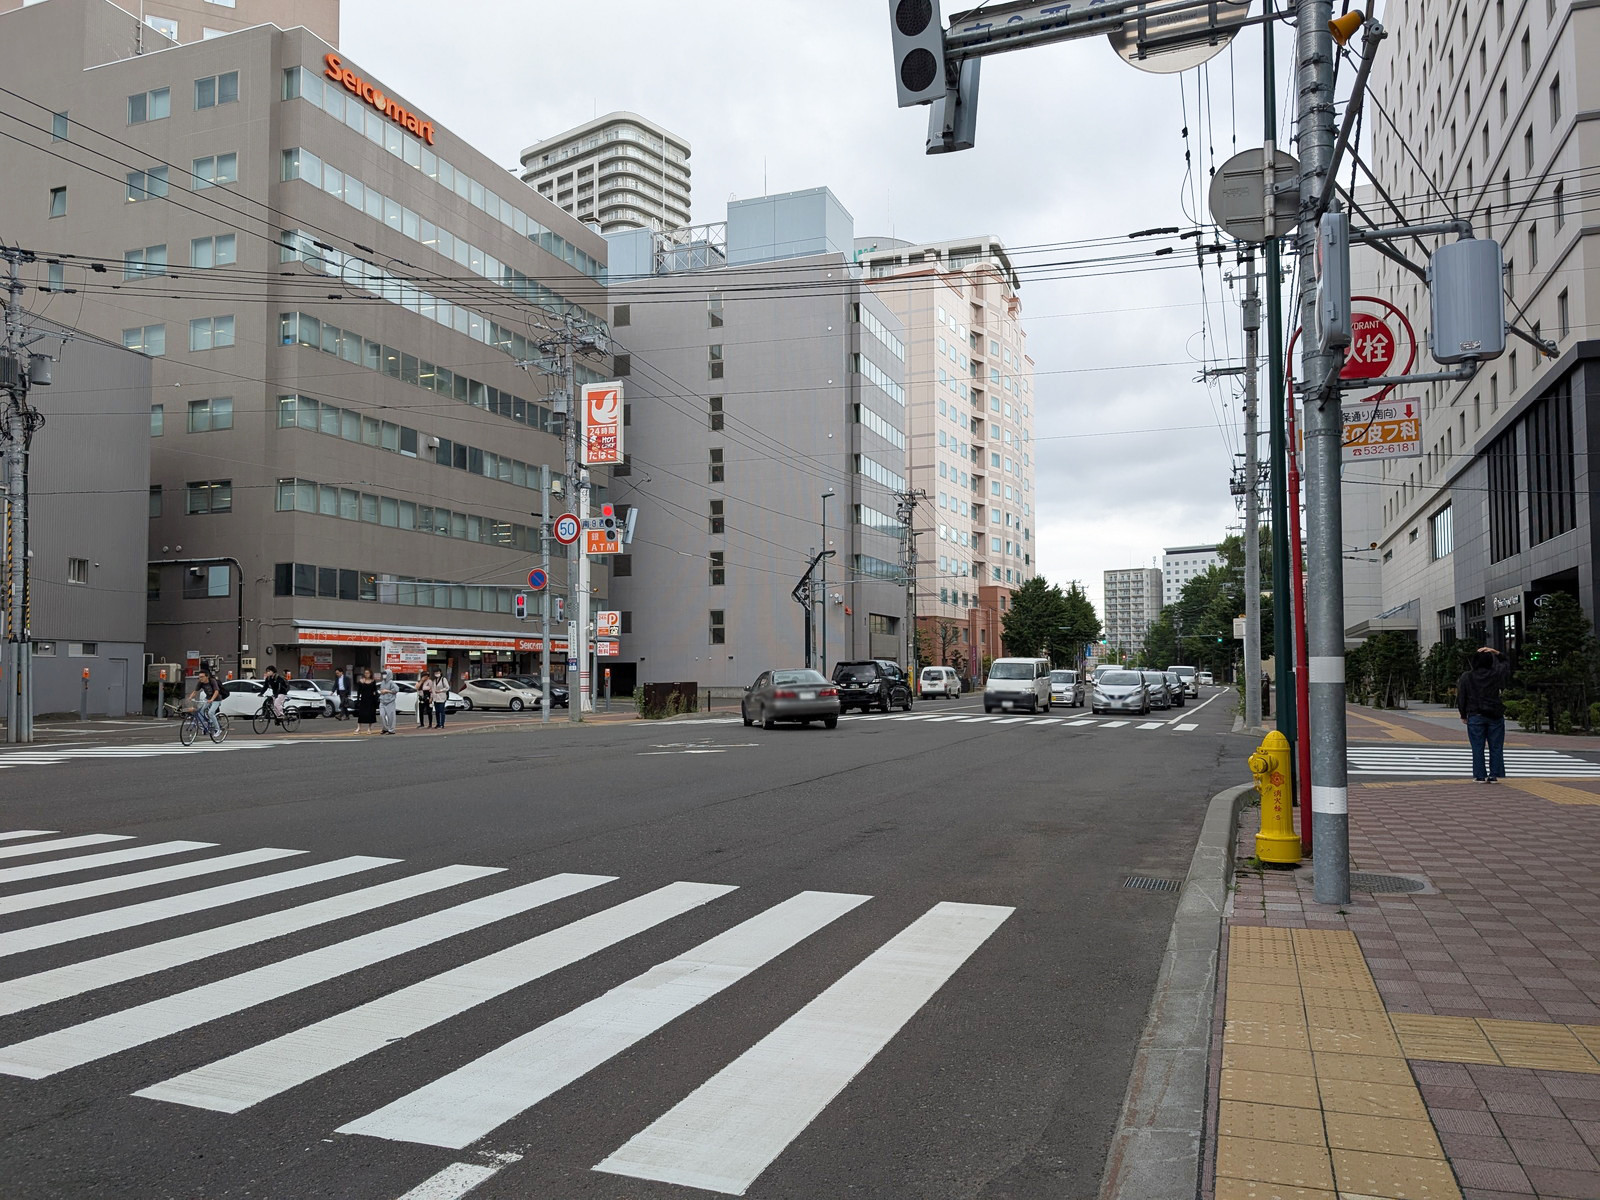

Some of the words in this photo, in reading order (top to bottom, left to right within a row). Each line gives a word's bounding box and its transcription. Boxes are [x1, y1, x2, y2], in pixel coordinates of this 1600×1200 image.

[325, 53, 434, 145] Seicomart
[1344, 333, 1388, 364] 火栓
[589, 450, 615, 460] たばこ
[1363, 443, 1416, 455] 532-6181
[560, 522, 575, 536] 50
[591, 543, 615, 552] ATM
[519, 640, 552, 650] Seicomt
